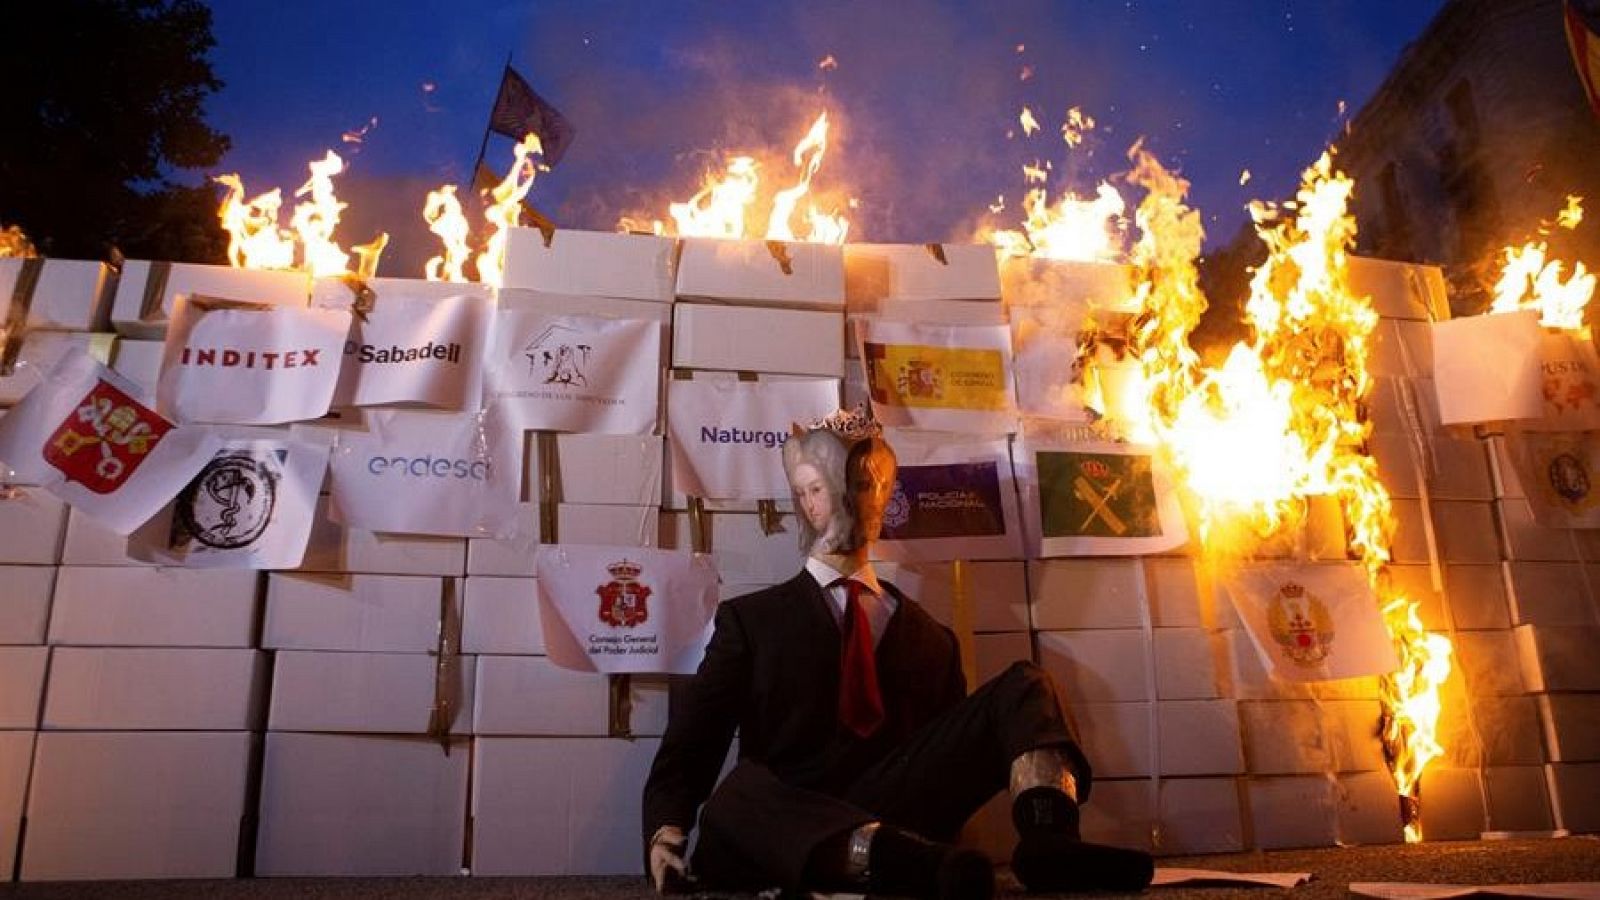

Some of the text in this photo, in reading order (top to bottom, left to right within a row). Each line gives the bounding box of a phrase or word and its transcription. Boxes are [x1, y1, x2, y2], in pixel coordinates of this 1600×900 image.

[180, 347, 321, 371] INDITEX
[357, 341, 461, 365] Sabadell
[701, 426, 789, 448] Naturgy
[368, 455, 491, 480] endesa
[588, 634, 657, 645] Consejo General
[589, 644, 659, 655] del Poder Judicial
